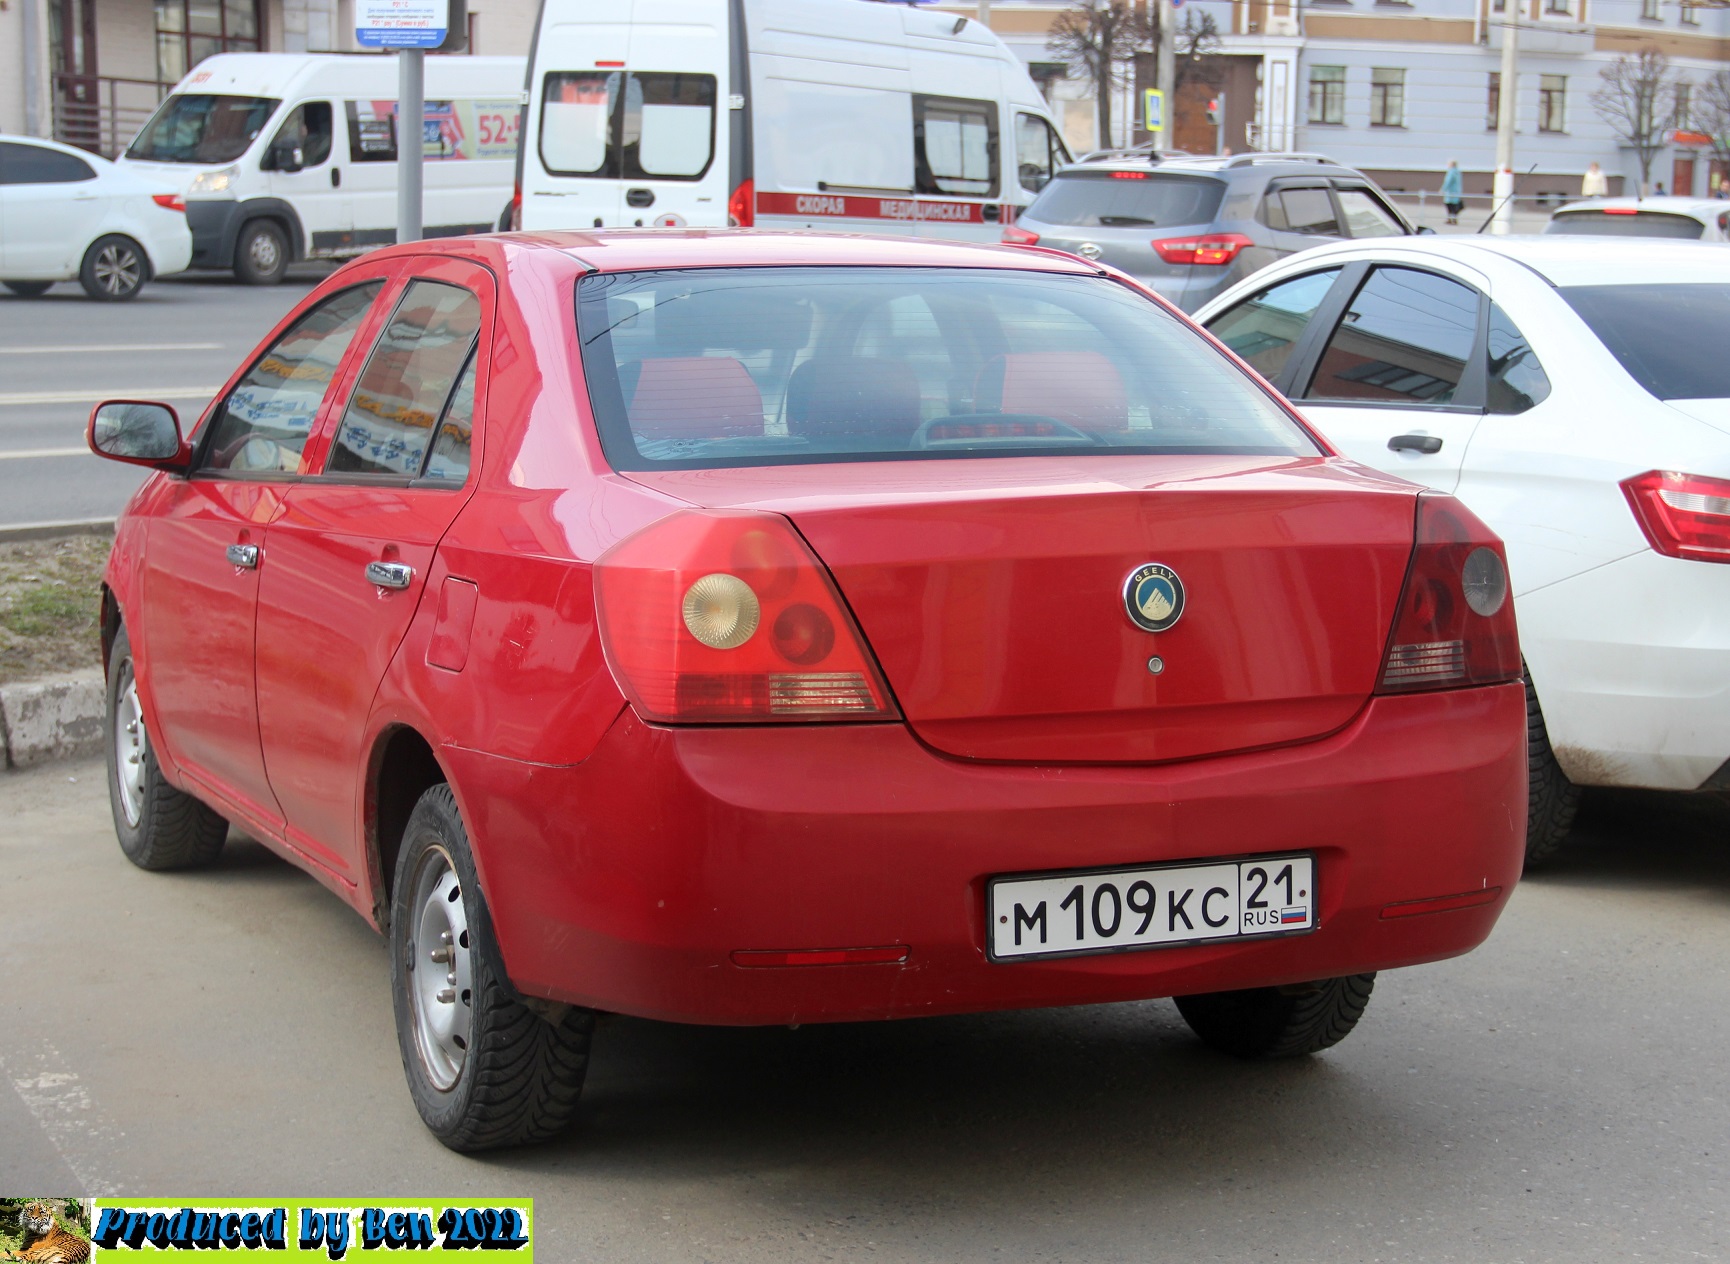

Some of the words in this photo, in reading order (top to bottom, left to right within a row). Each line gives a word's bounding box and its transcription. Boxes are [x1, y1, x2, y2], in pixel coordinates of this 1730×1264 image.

[796, 196, 845, 215] СКОРАЯ
[880, 199, 971, 221] МЕДИЦИНСКАЯ
[1135, 567, 1174, 582] GEELY
[1246, 864, 1293, 909] 21
[1243, 910, 1279, 927] RUS
